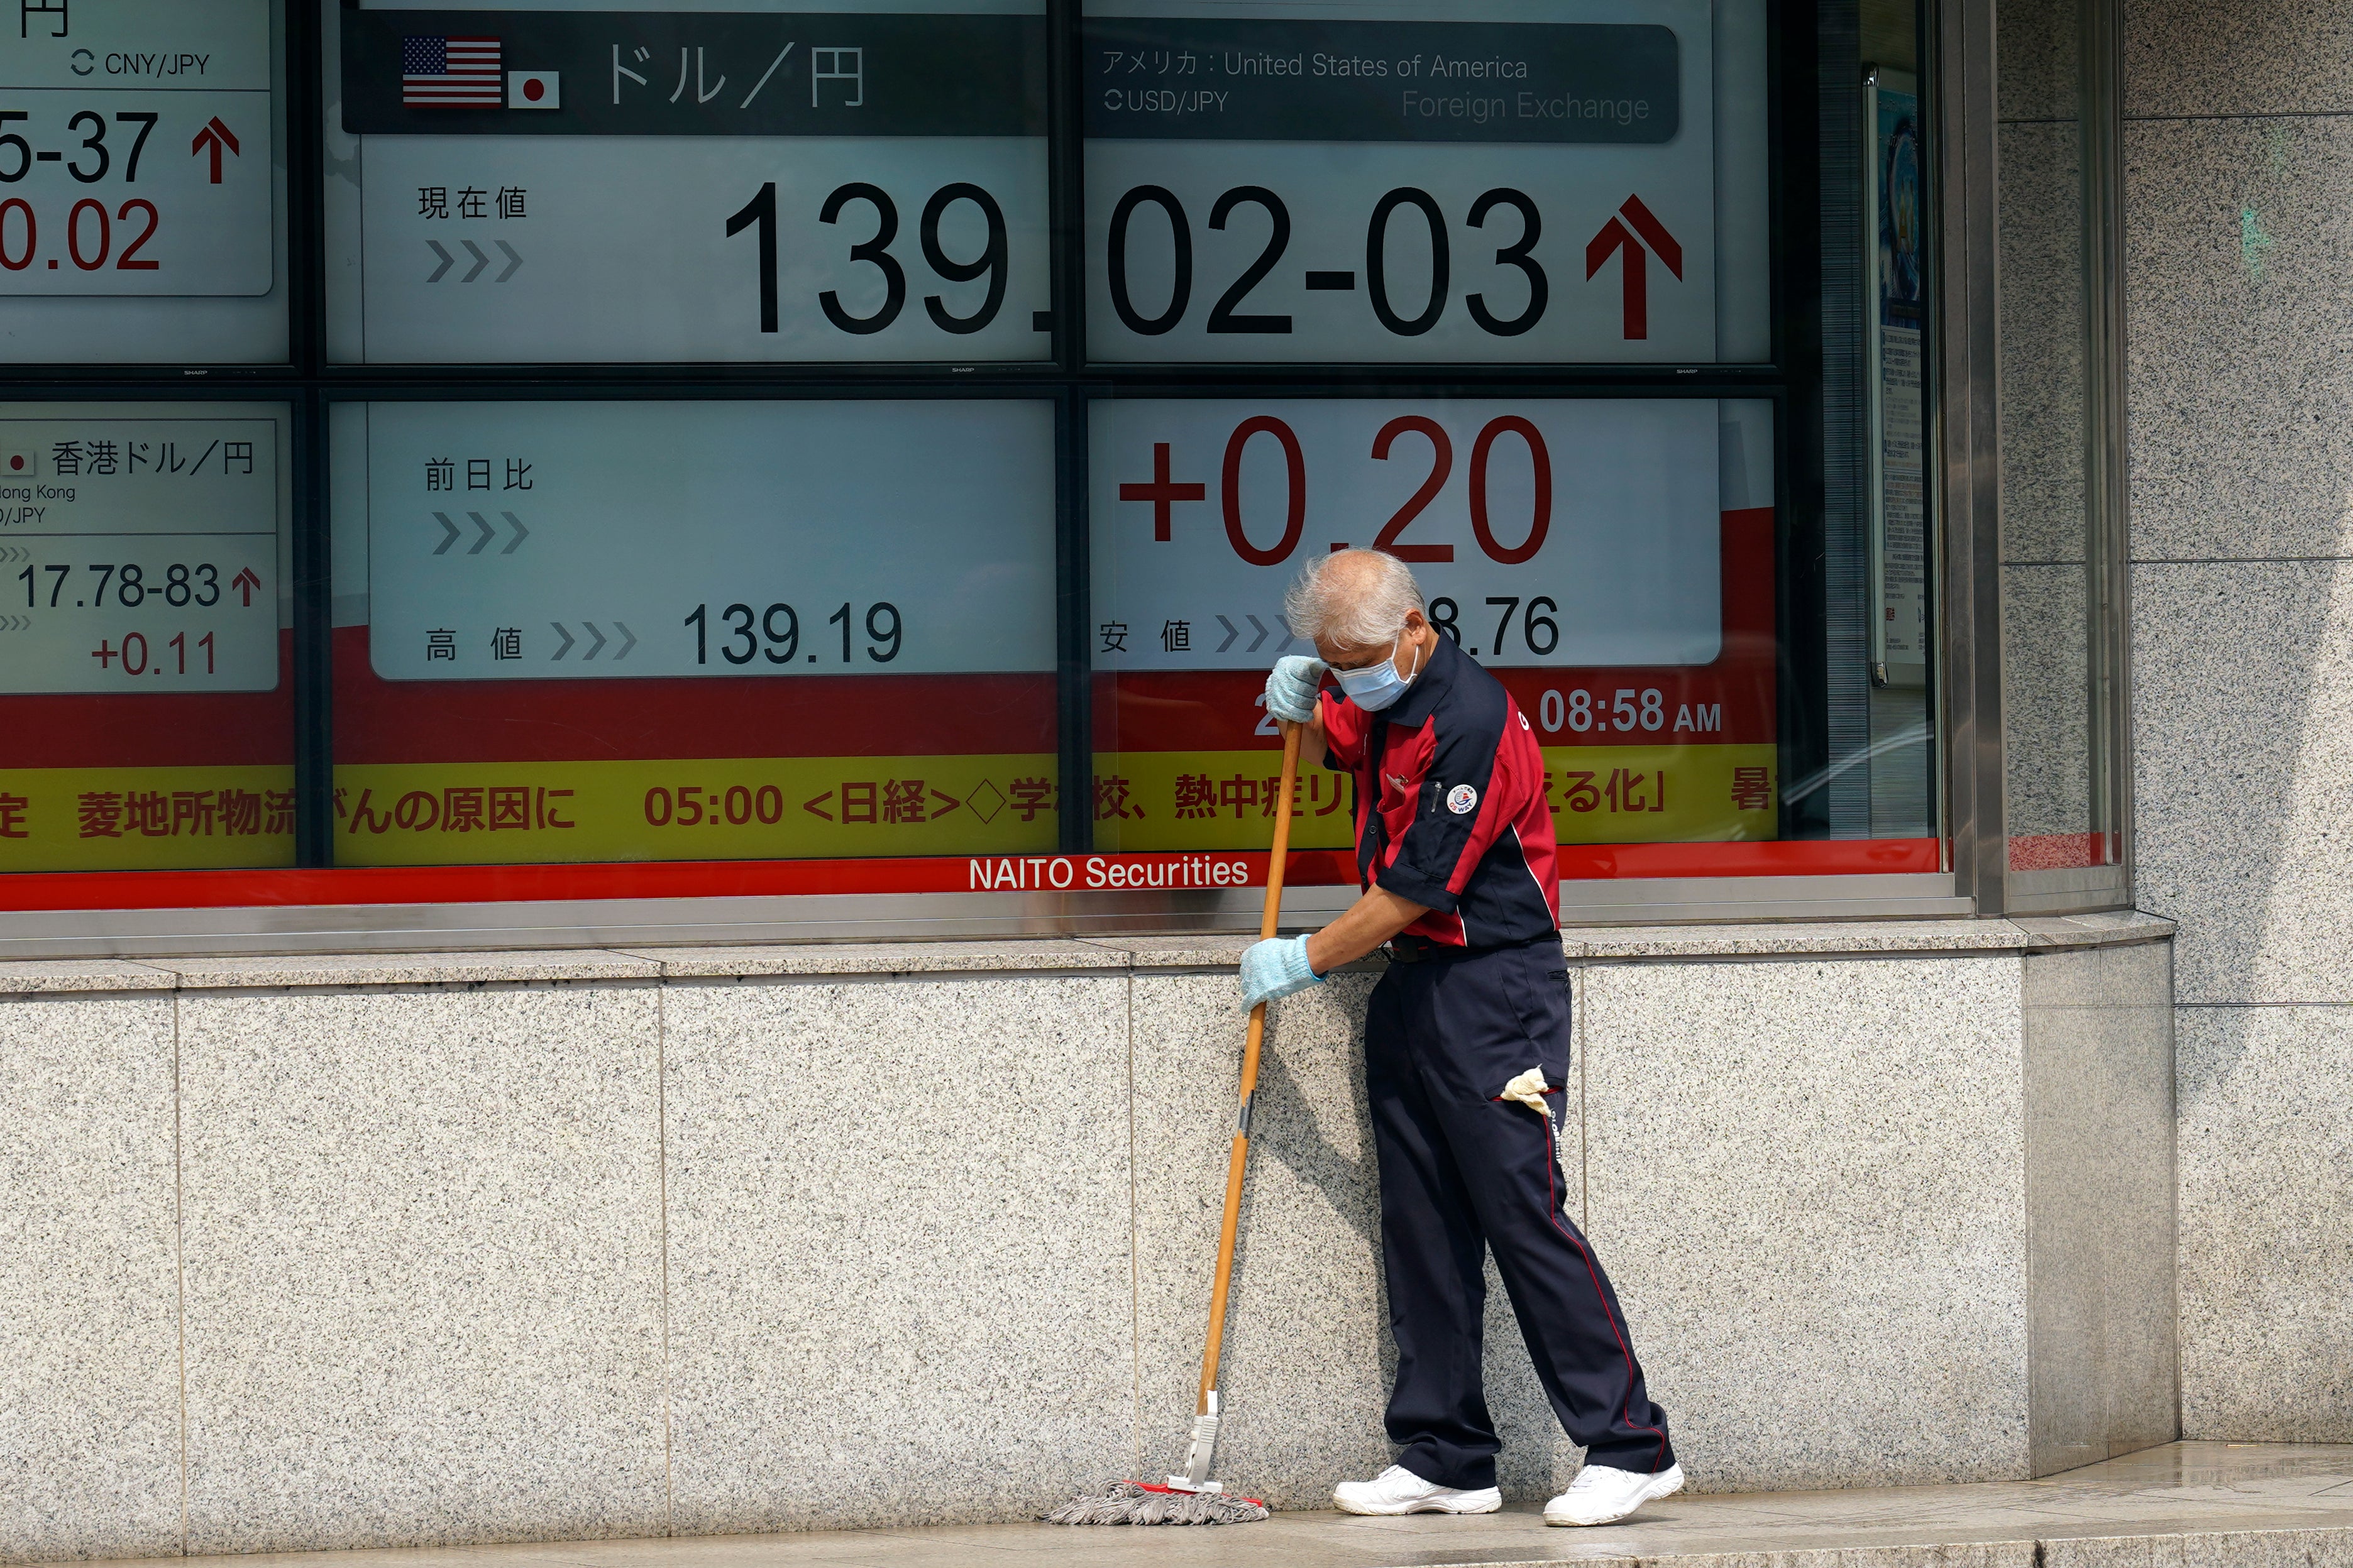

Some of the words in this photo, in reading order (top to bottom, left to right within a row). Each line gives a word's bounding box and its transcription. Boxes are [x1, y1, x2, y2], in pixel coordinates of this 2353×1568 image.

[106, 53, 209, 78] CNY/JPY
[1225, 52, 1302, 75] United
[1313, 53, 1388, 77] States
[1397, 55, 1422, 77] of
[1430, 55, 1527, 78] America
[1128, 90, 1228, 116] USD/JPY
[1403, 91, 1506, 123] Foreign
[1518, 92, 1649, 125] Exchange
[418, 186, 527, 219] 現在値
[0, 198, 159, 270] 0.02
[425, 458, 533, 491] 前日比
[1119, 415, 1552, 566] +0.20
[0, 485, 30, 502] ong
[37, 485, 75, 502] Kong
[0, 507, 46, 526] /JPY
[19, 564, 220, 608] 17.78-83
[685, 601, 902, 664] 139.19
[92, 631, 216, 676] +0.11
[1540, 688, 1664, 732] 08:58
[1673, 704, 1721, 732] AM
[644, 784, 784, 827] 05:00
[1449, 802, 1458, 811] GS
[1458, 802, 1472, 812] WAY
[969, 858, 1074, 889] NAITO
[1086, 855, 1249, 888] Securities
